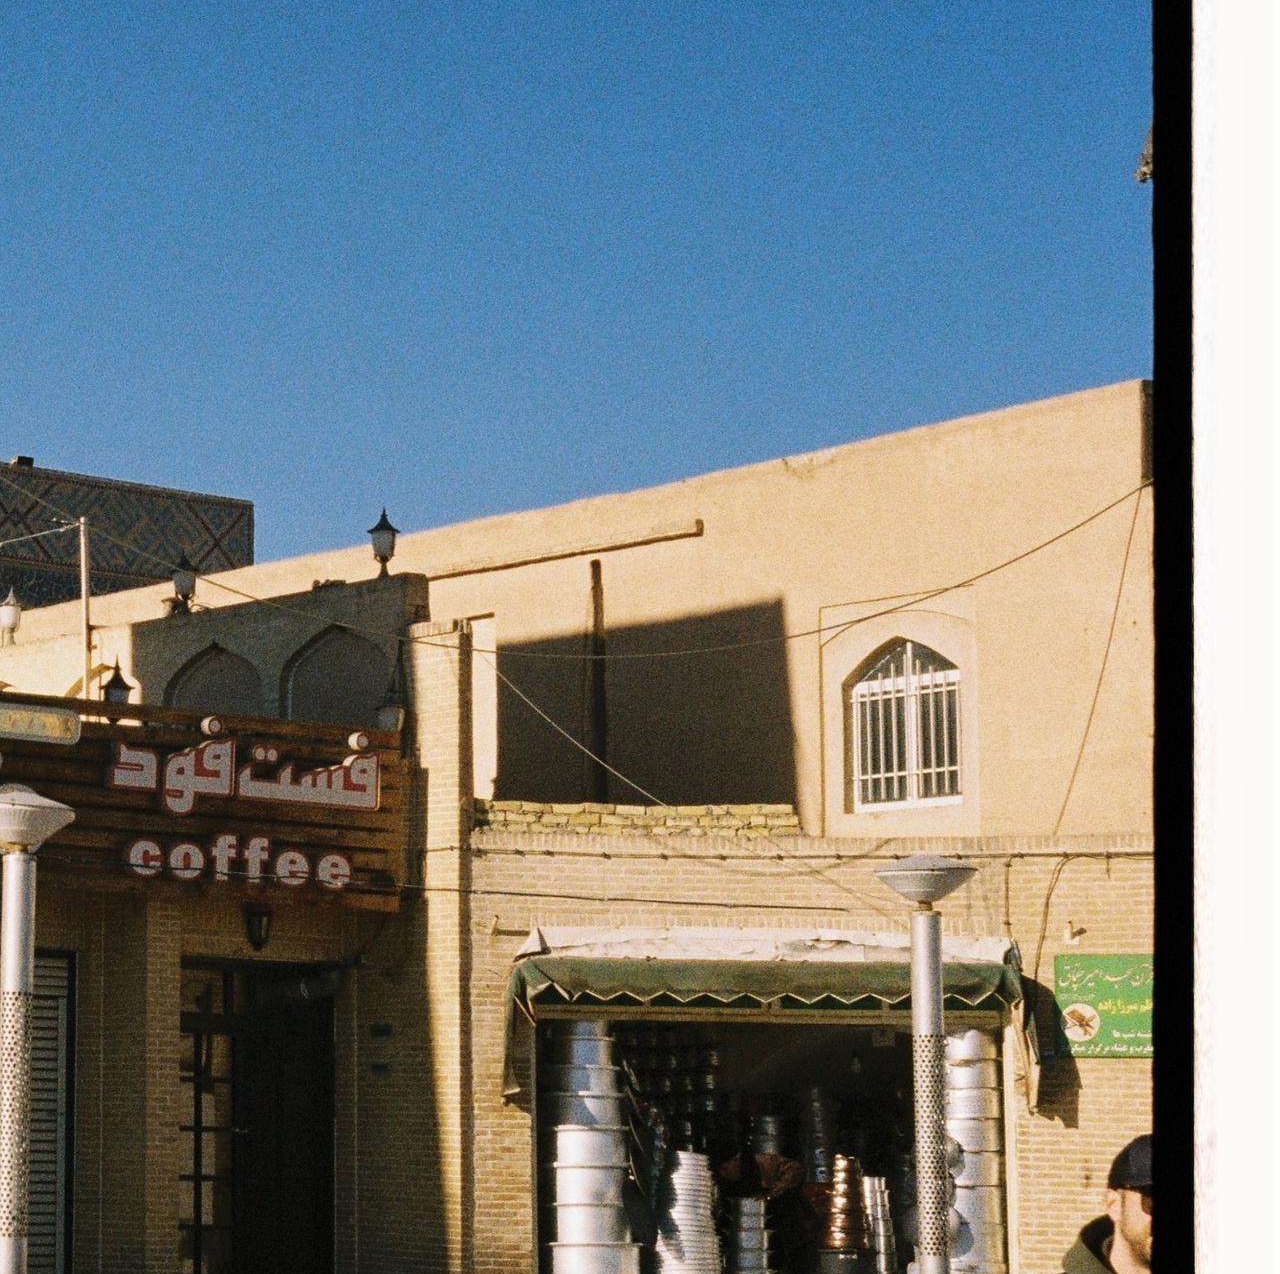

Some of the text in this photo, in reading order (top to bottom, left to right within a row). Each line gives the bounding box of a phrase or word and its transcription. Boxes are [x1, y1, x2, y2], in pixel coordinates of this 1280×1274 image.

[112, 715, 380, 816] فست فود
[129, 834, 352, 889] coffee
